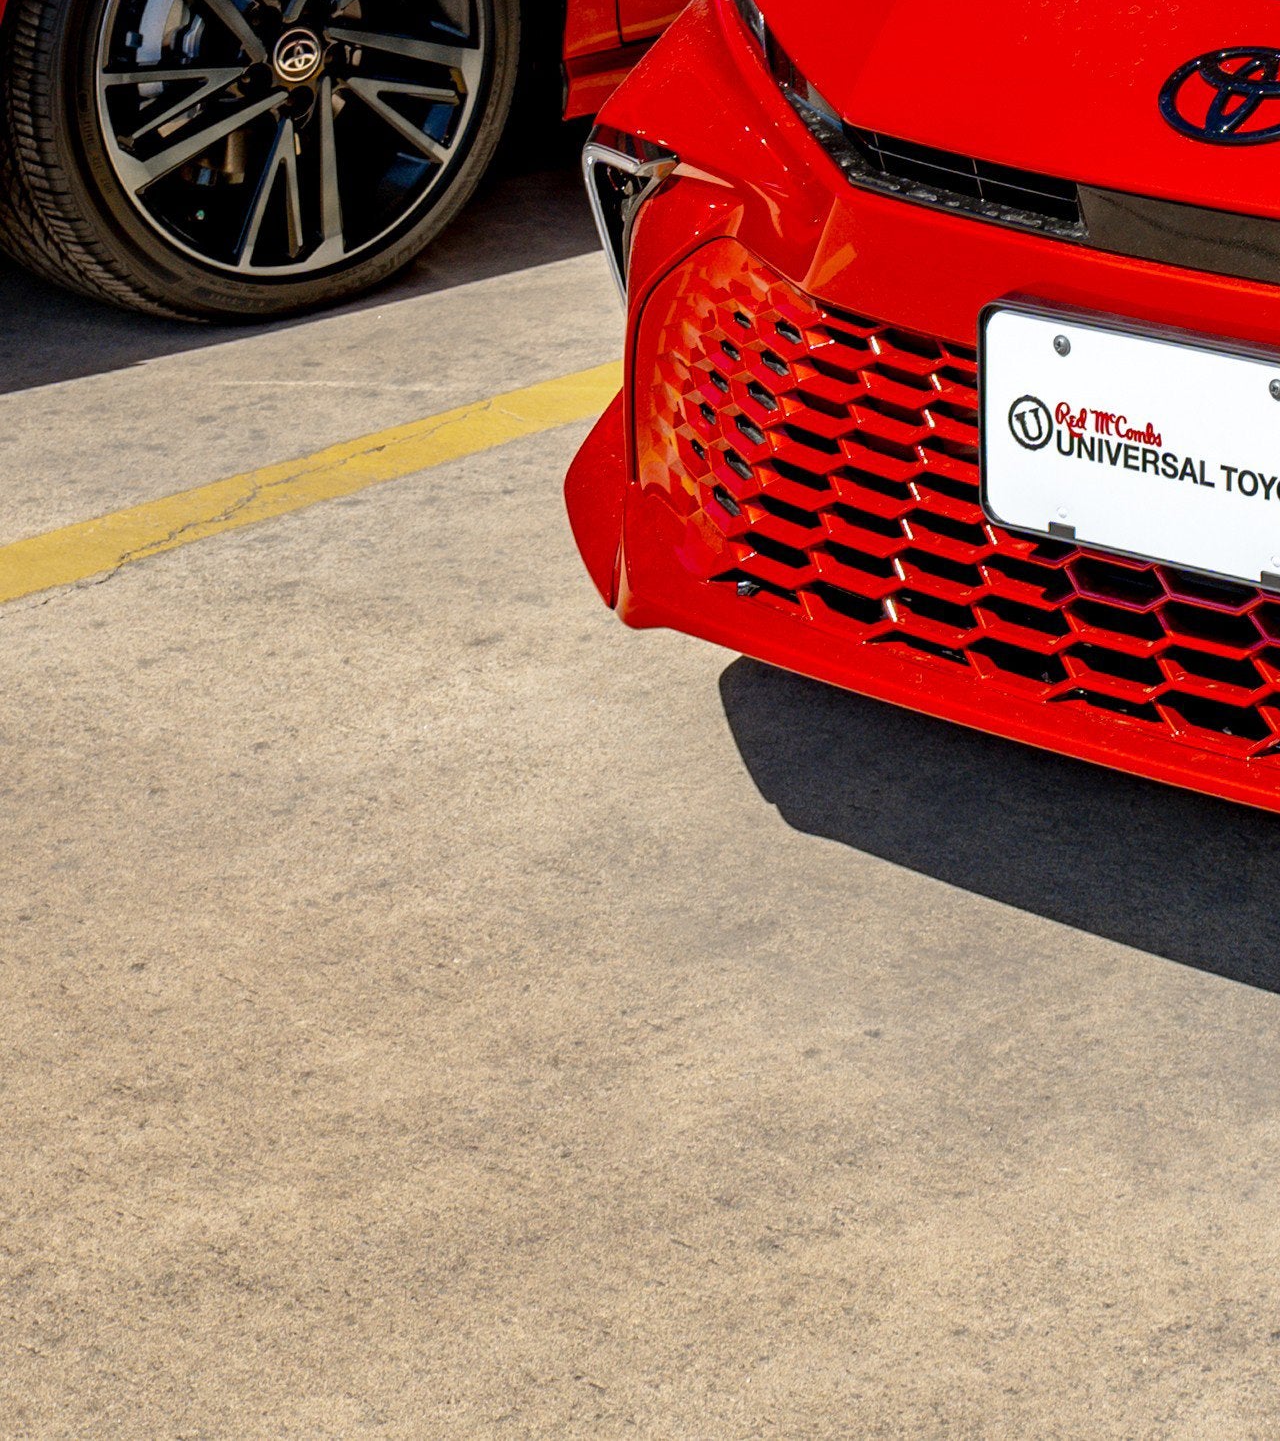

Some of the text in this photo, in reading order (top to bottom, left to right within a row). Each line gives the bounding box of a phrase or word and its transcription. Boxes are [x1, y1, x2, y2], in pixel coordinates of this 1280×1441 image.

[1055, 402, 1162, 447] Red McCombs
[1057, 429, 1215, 488] UNIVERSAL
